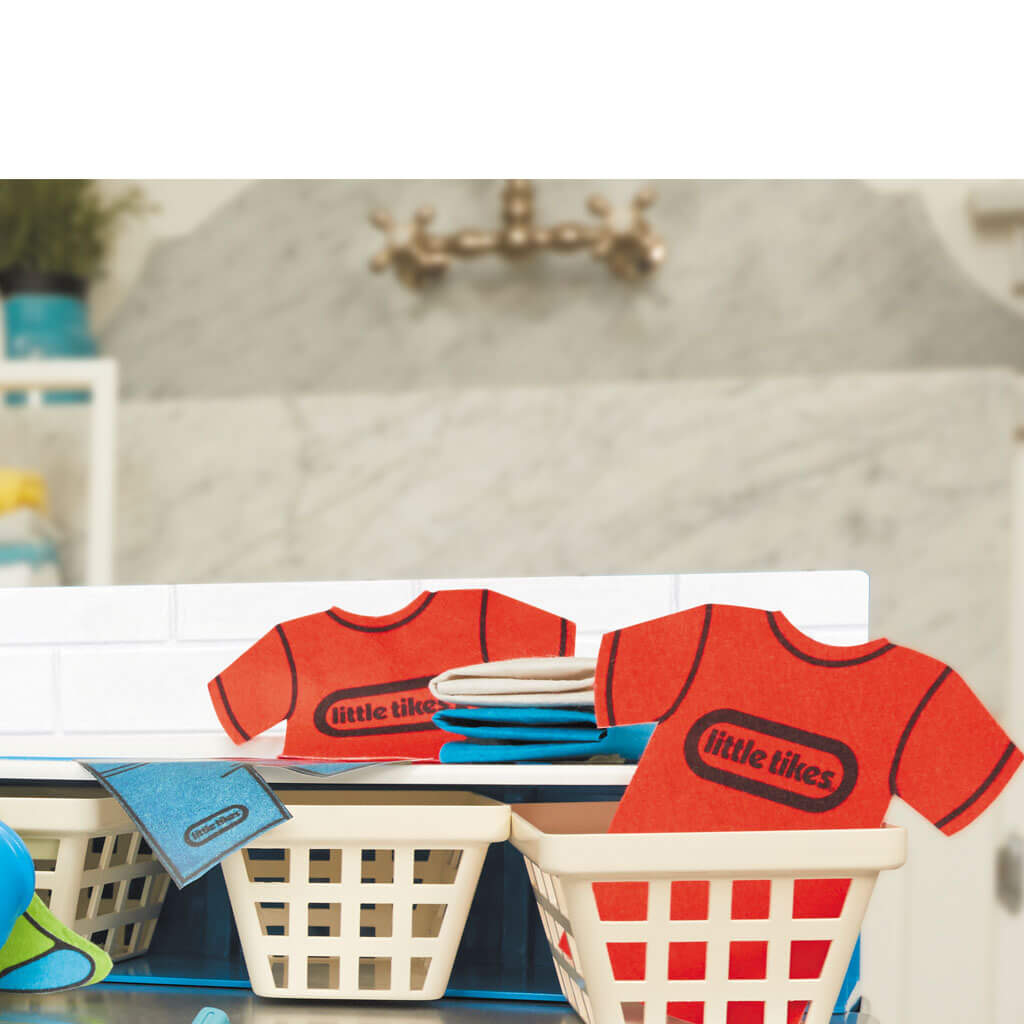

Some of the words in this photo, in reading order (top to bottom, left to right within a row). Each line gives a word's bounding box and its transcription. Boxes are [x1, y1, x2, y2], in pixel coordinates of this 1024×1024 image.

[332, 703, 387, 724] little
[704, 729, 767, 769] little
[768, 750, 836, 790] tikes
